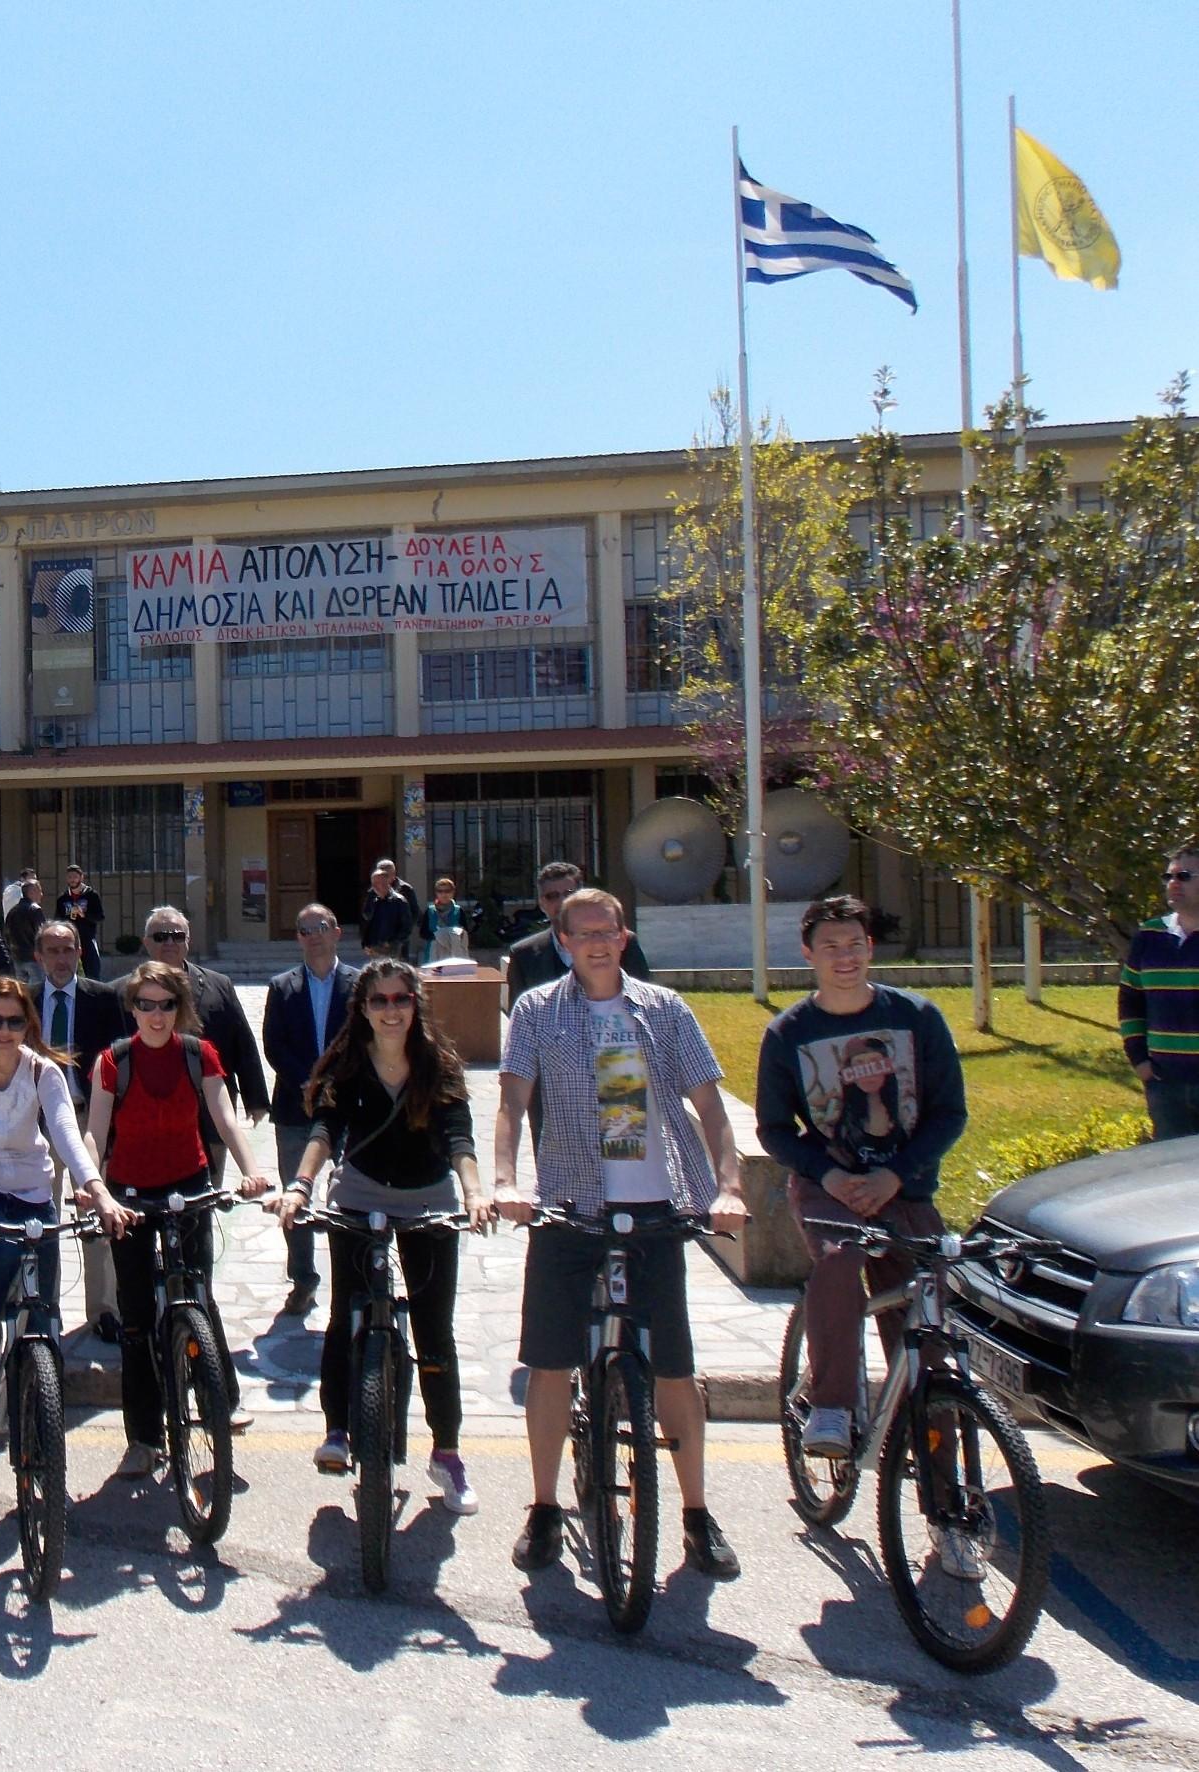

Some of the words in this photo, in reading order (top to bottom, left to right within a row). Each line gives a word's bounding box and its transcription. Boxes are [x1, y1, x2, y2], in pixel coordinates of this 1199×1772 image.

[25, 510, 156, 541] ΠΑΤΡΩΝ
[405, 535, 506, 556] ΔΟΥΛΕΙΑ
[133, 549, 229, 589] ΚΑΜΙΑ
[413, 559, 449, 577] ΓΙΑ
[461, 553, 545, 576] ΟΛΟΥΣ
[134, 592, 265, 632] ΔΗΜΟΣΙΑ
[275, 588, 314, 623] ΚΑΙ
[325, 584, 427, 618] ΔΩΡΕΑΝ
[438, 577, 562, 613] ΠΑΙΔΕΙΑ
[140, 629, 203, 646] ΣΥΛΛΟΓΟΣ
[217, 624, 306, 641] ΔΙΟΙΚΗΤΙΚΩΝ
[393, 618, 485, 631] ΠΑΝΕΠΙΣΤΗΜΙΟΥ
[495, 614, 551, 627] ΠΑΤΡΩΝ
